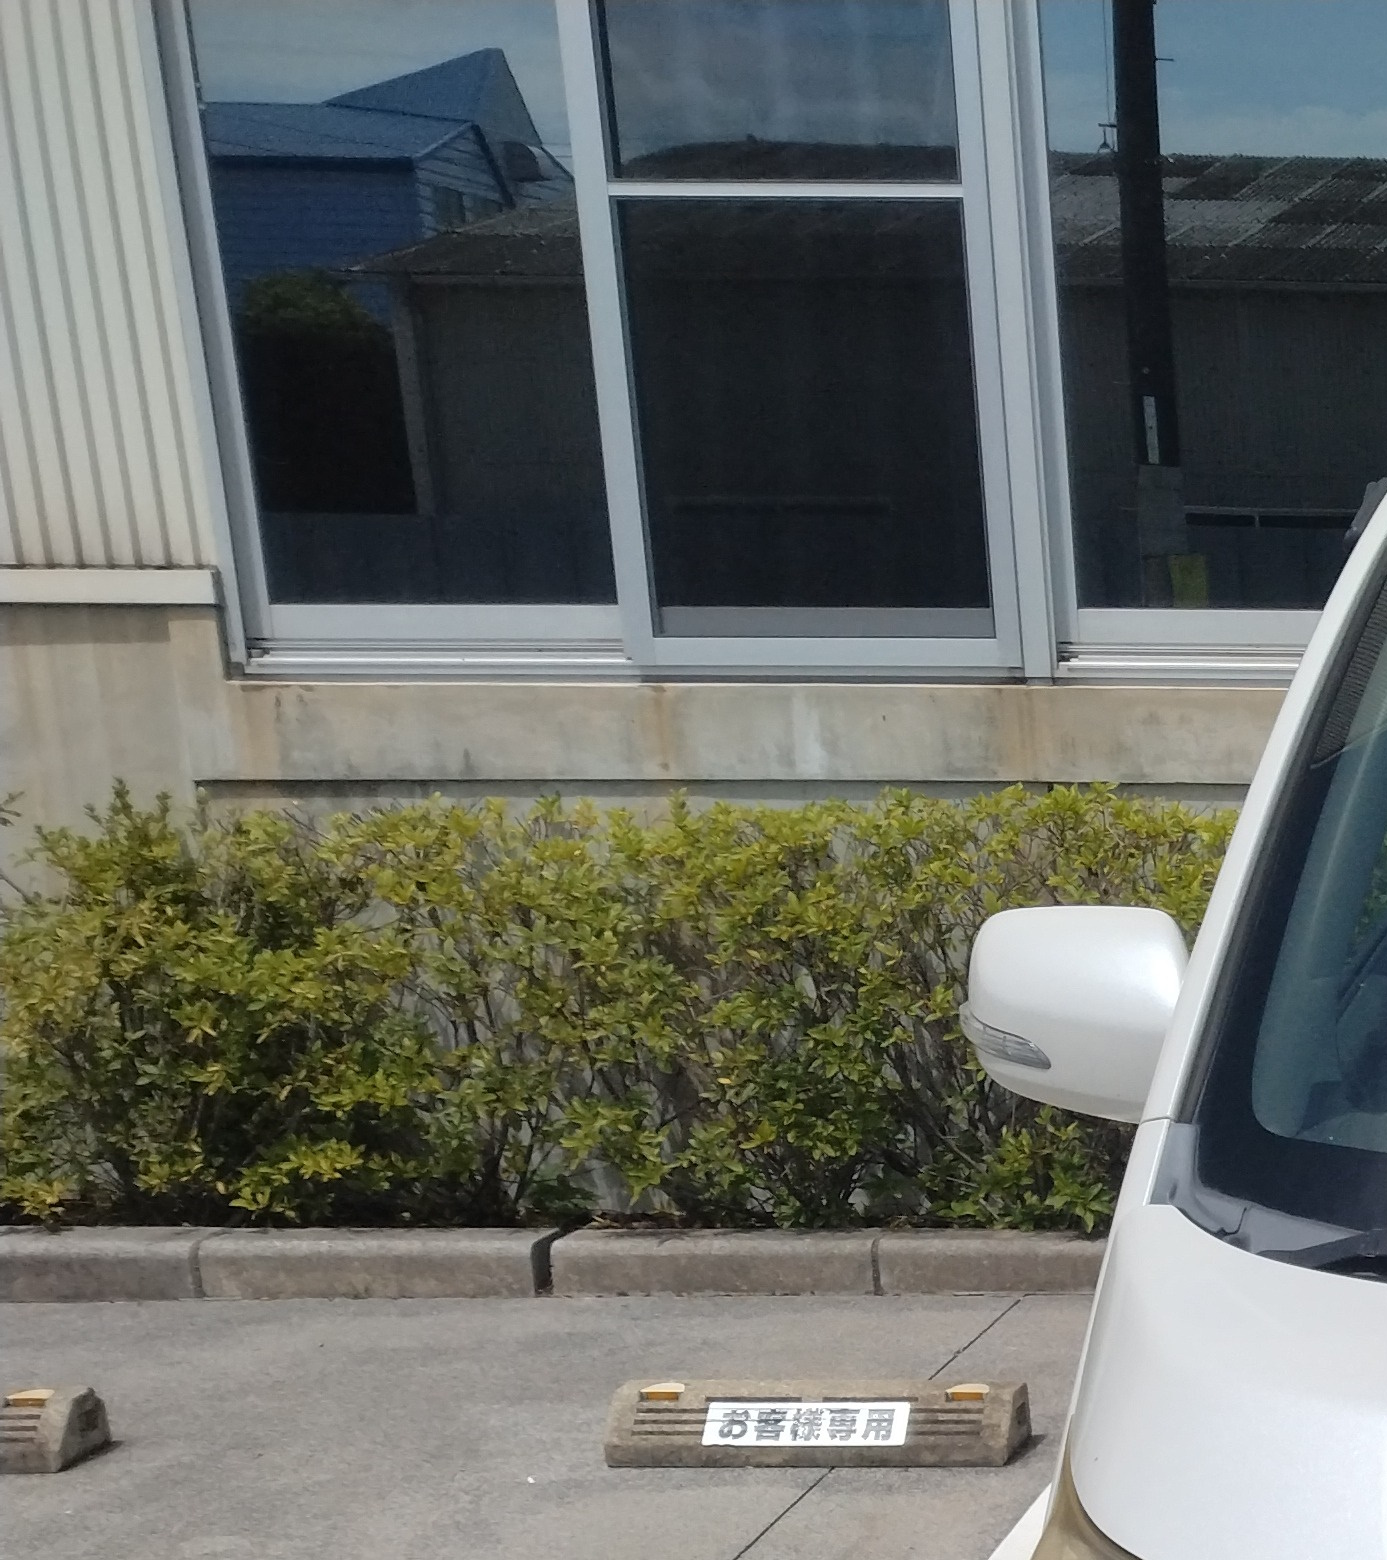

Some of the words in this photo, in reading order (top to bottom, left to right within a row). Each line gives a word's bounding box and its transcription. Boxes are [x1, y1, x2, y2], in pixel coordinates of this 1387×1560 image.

[718, 1408, 897, 1442] お客様専用
